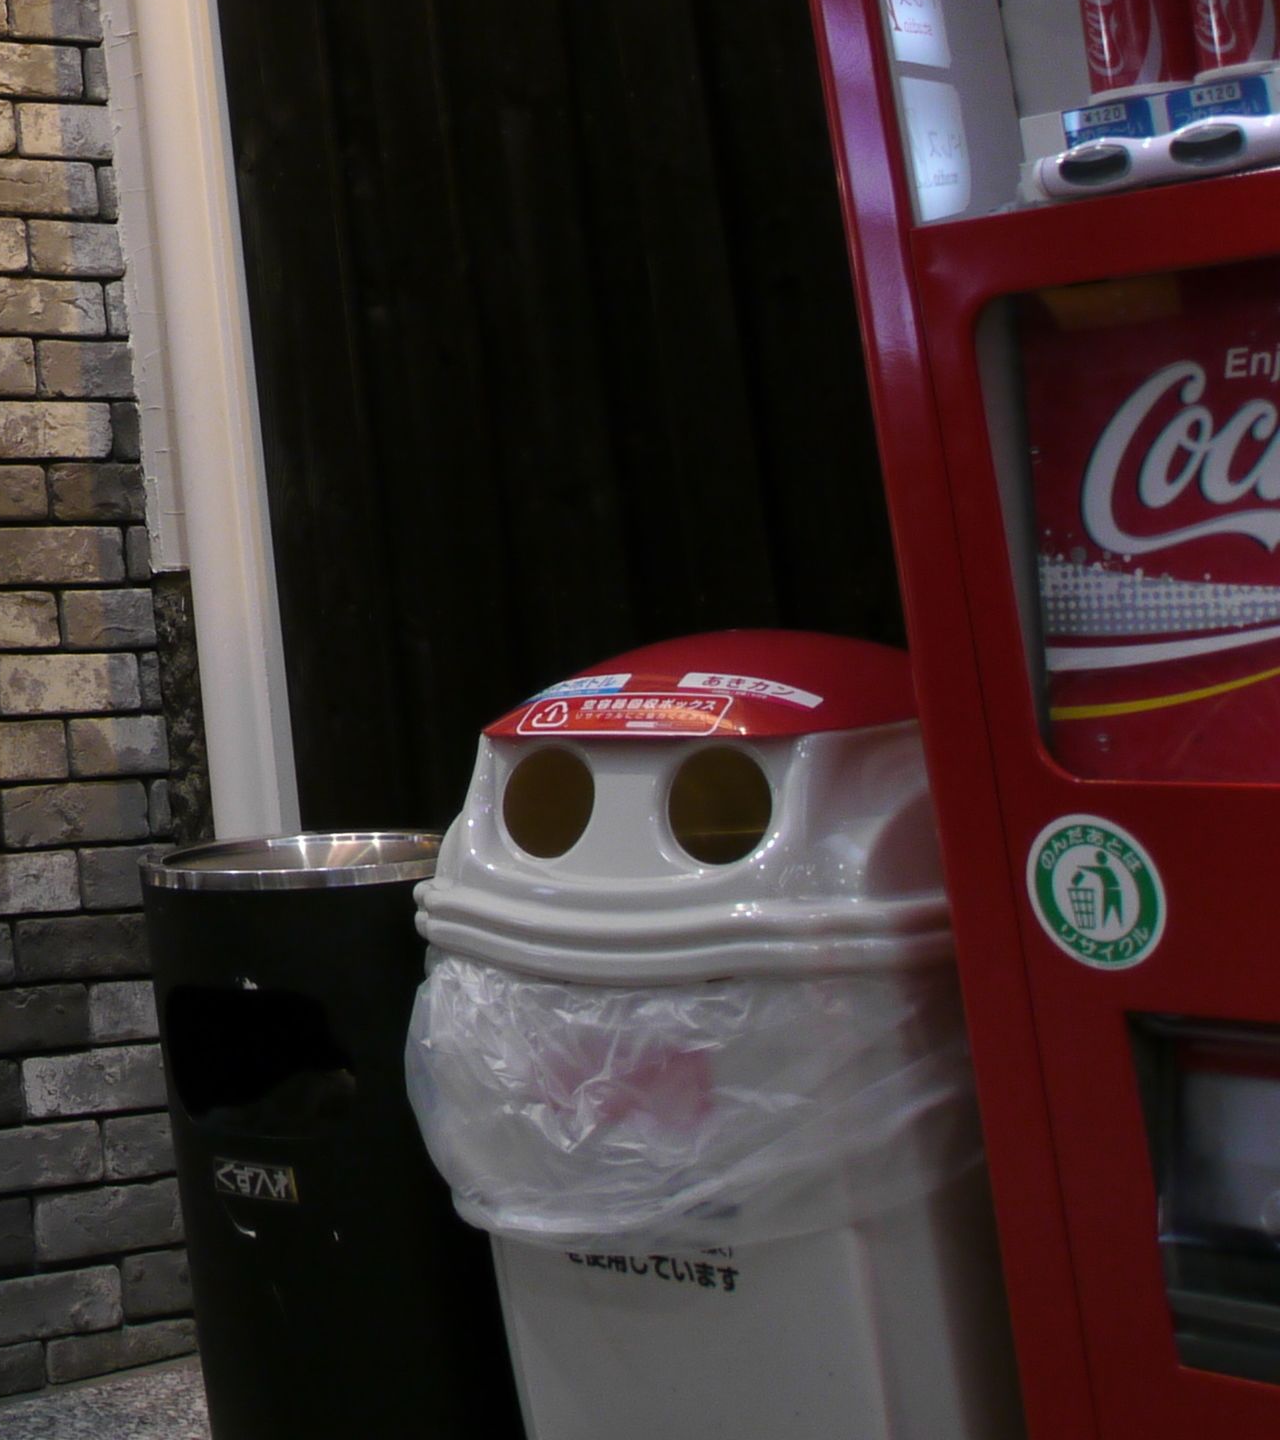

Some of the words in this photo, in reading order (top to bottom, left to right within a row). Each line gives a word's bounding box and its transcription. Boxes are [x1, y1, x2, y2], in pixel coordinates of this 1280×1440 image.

[1061, 926, 1149, 961] リサイクル
